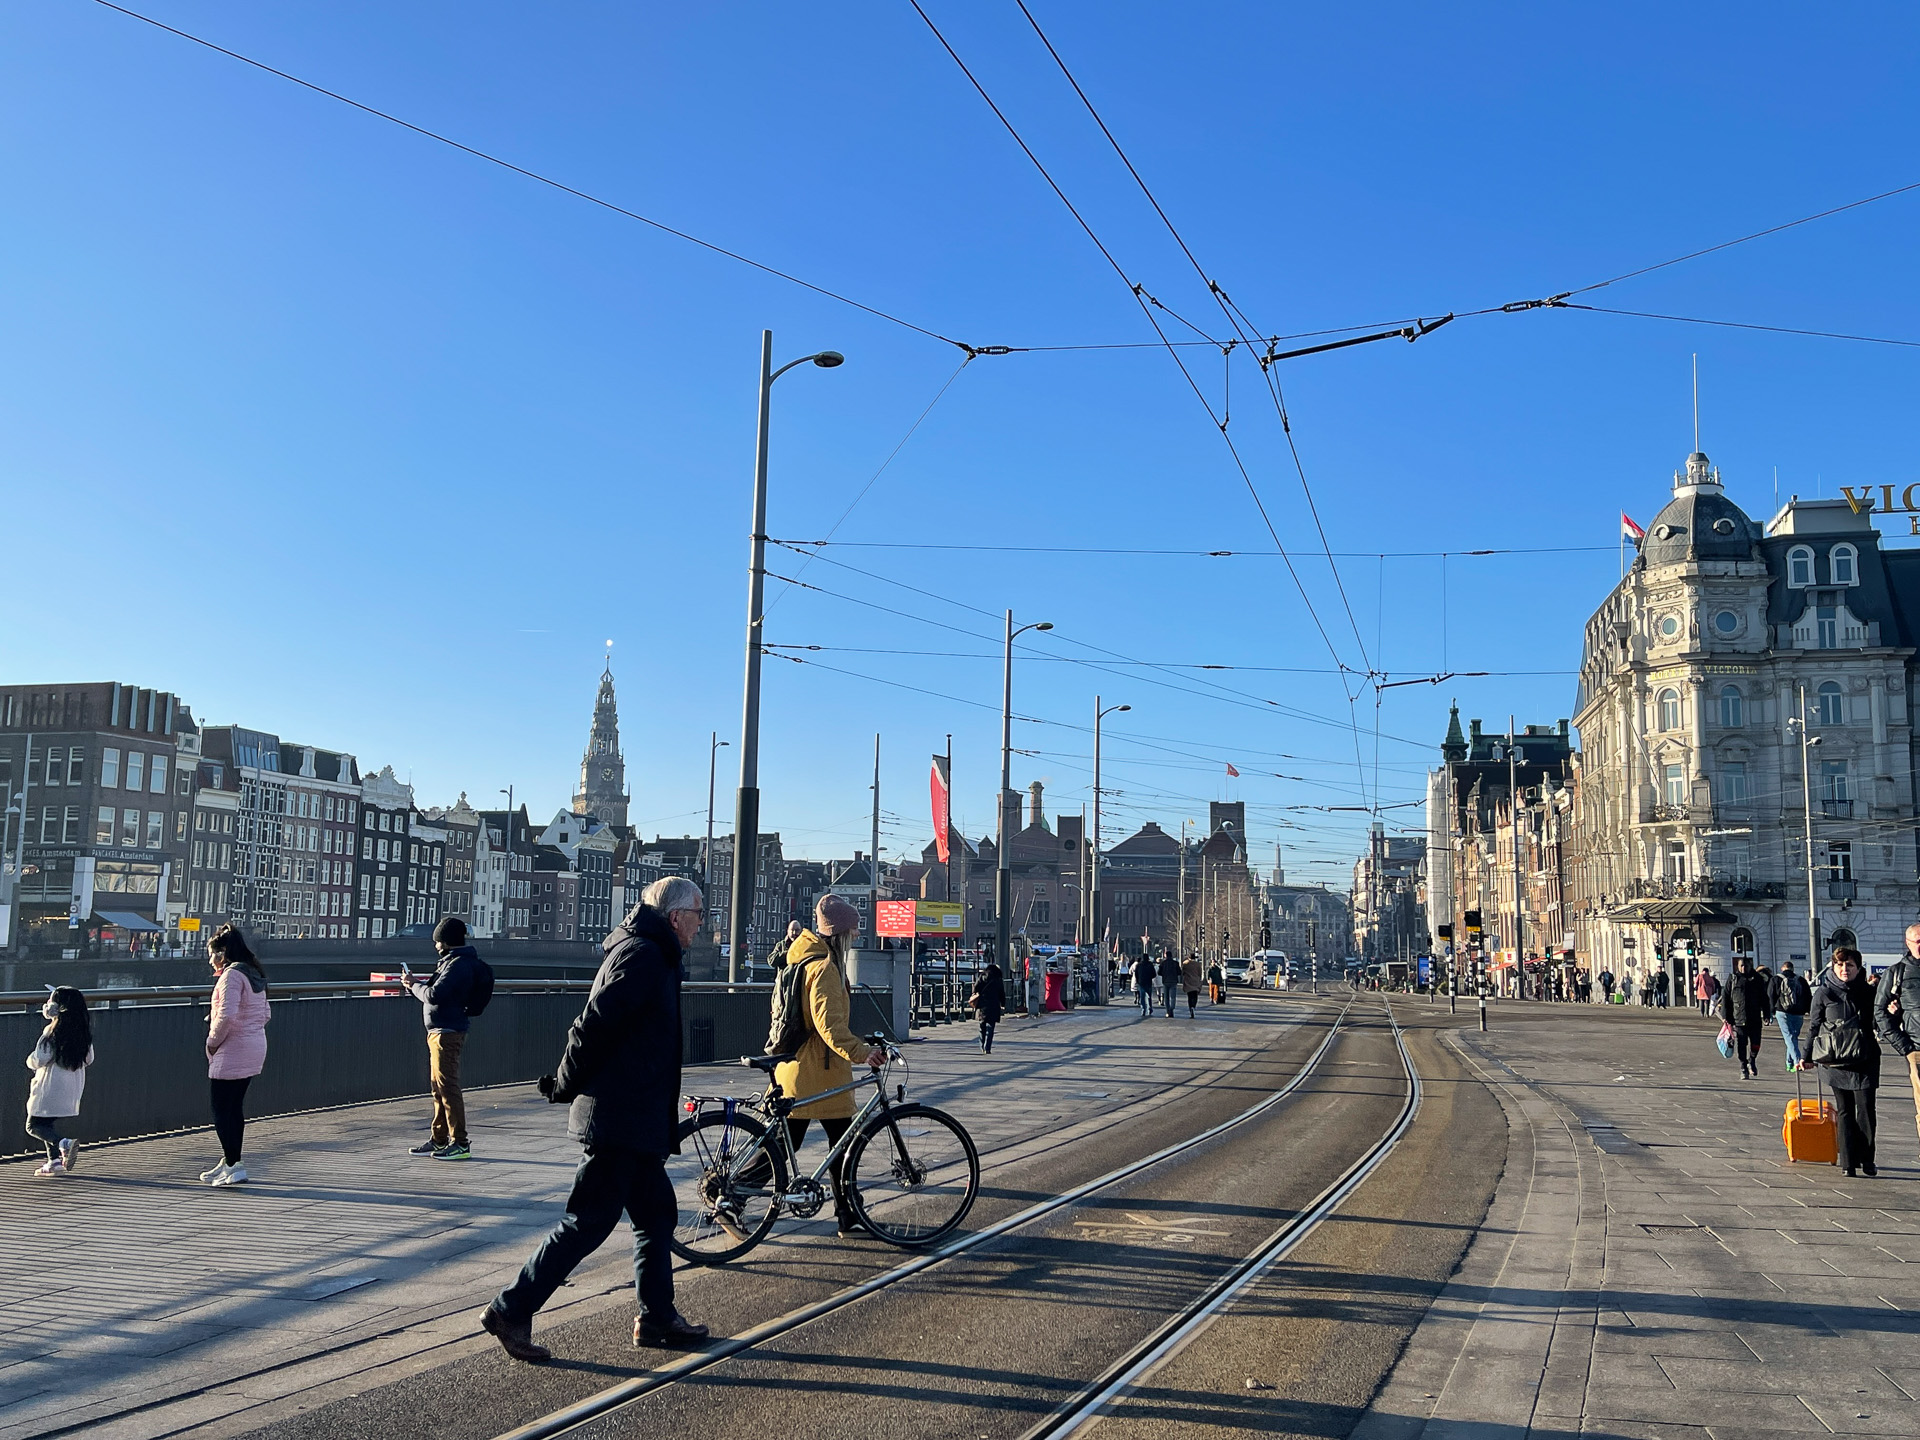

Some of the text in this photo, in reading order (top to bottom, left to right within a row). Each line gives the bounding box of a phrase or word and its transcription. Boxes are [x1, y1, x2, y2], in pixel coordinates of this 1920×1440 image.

[1650, 665, 1757, 680] HOTEL VICTORIA
[41, 849, 81, 857] Amsterdam
[119, 851, 154, 861] Amsterdam
